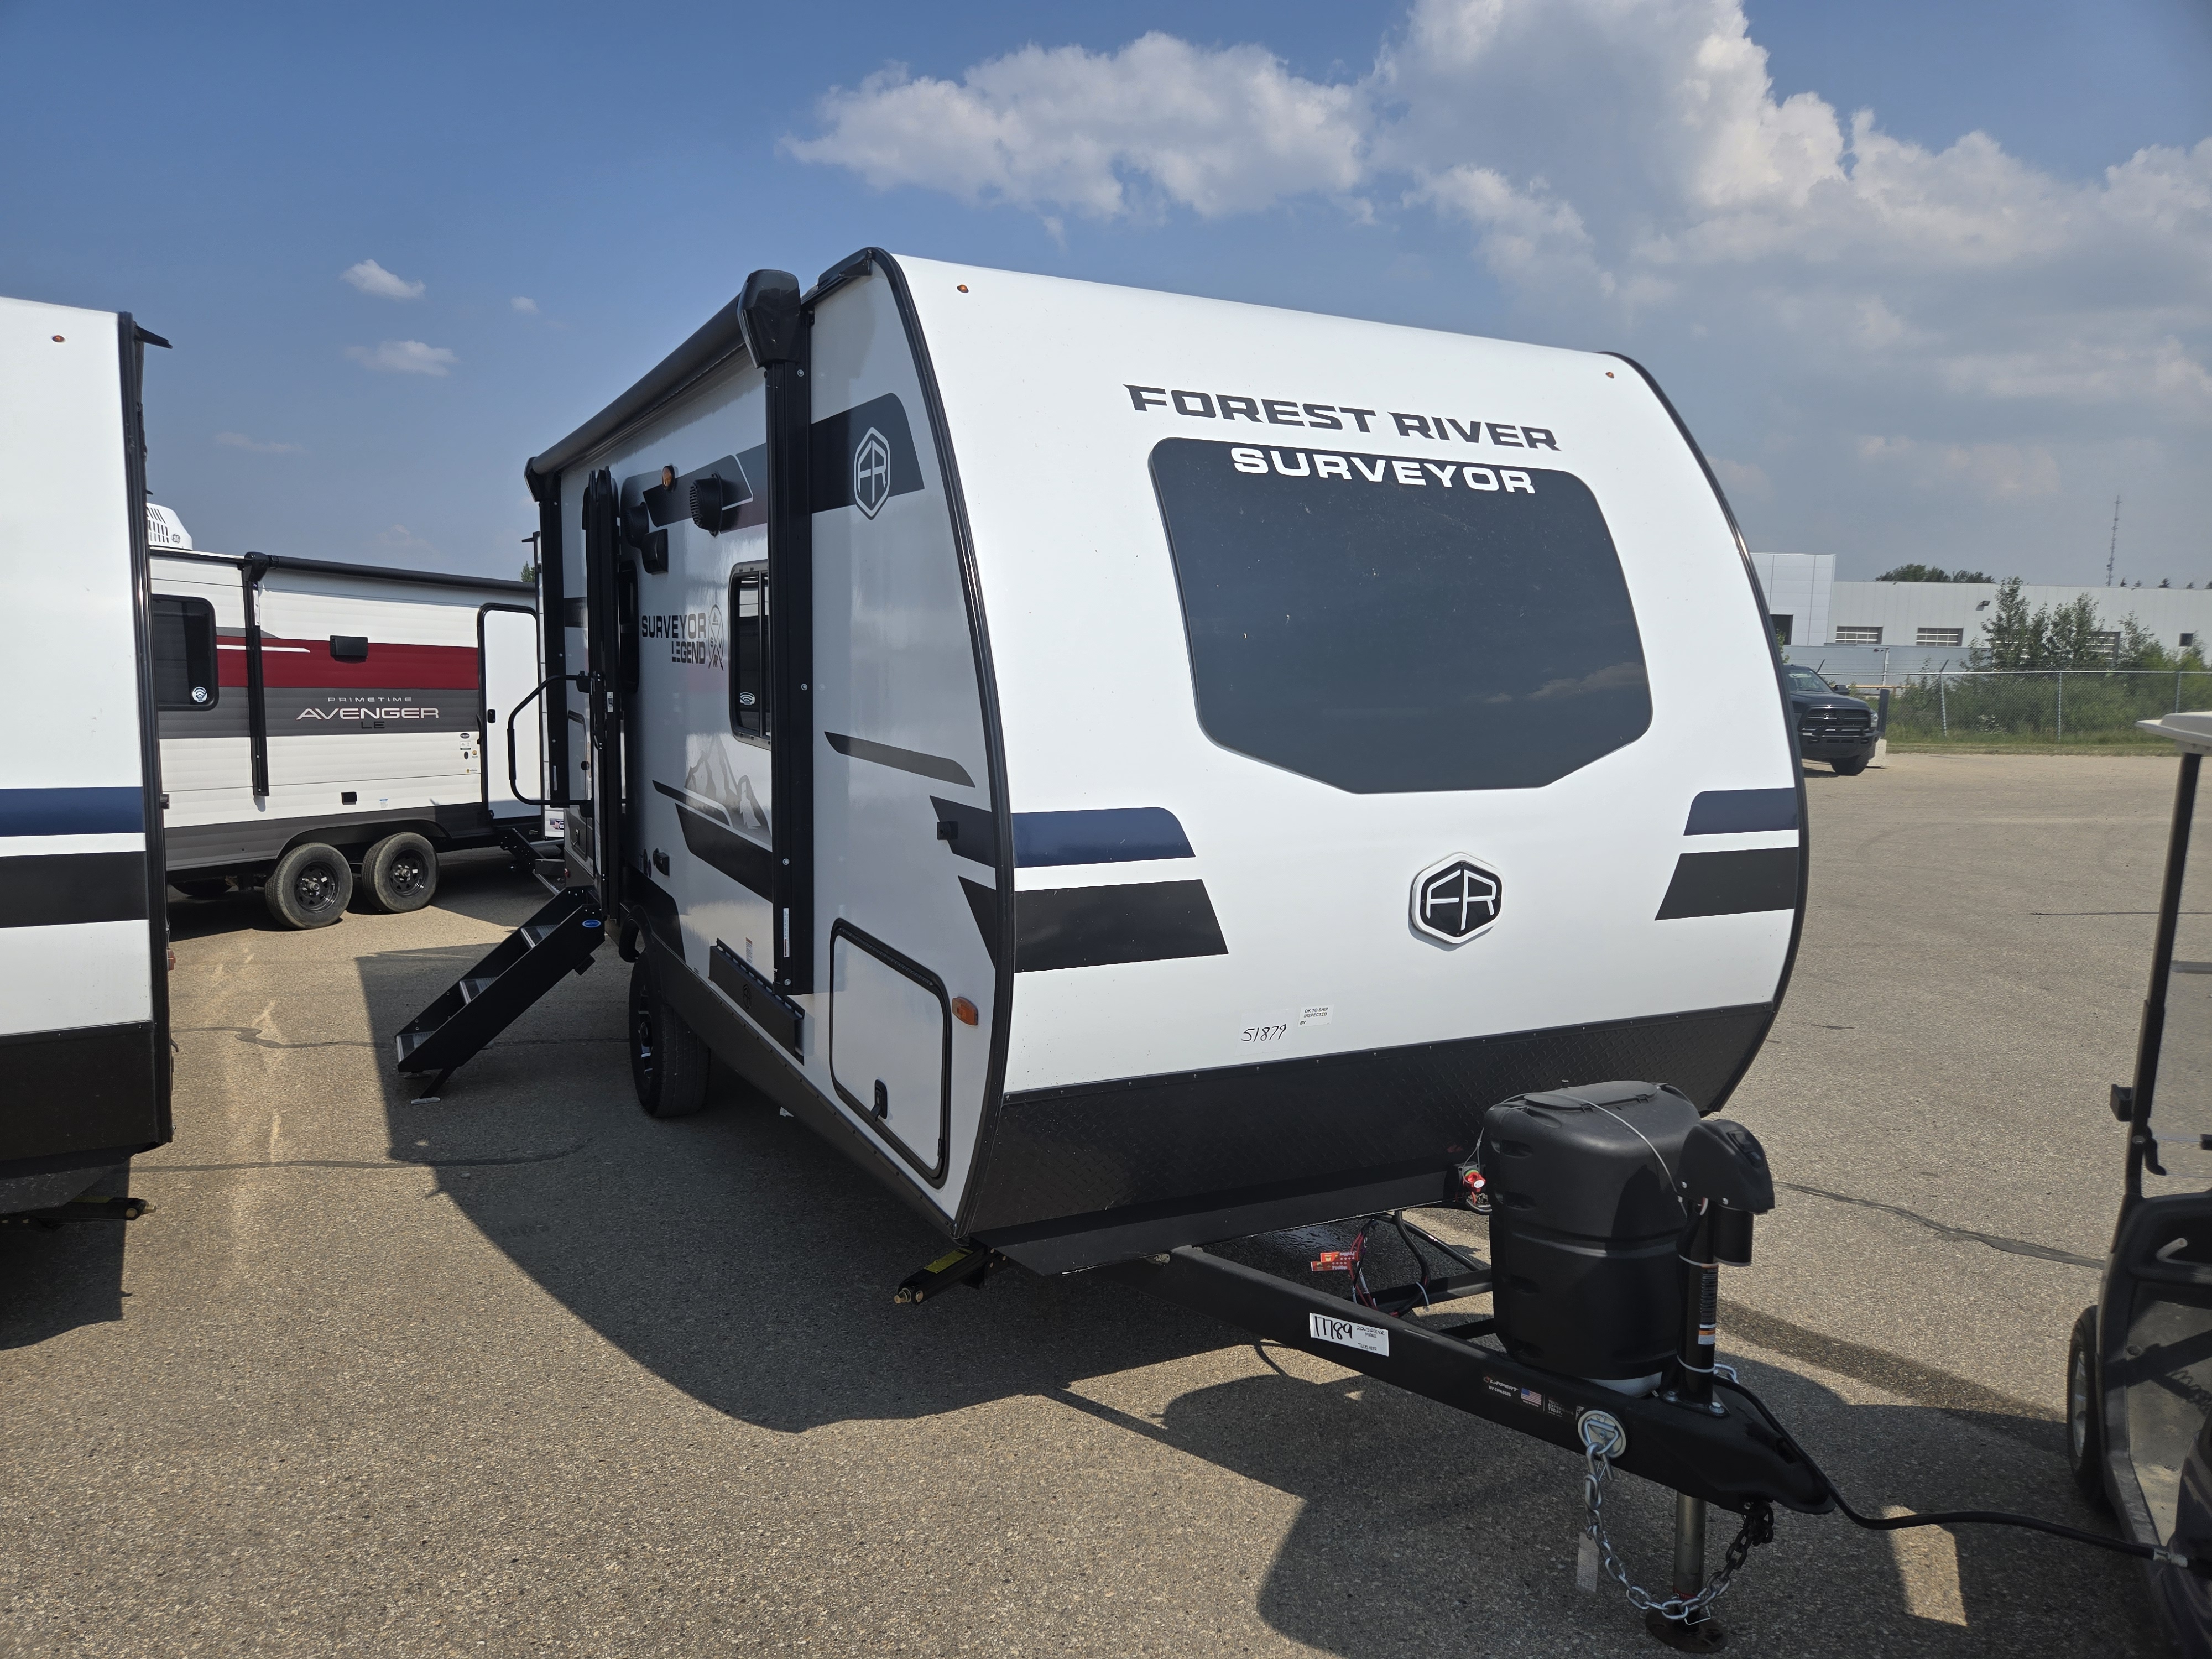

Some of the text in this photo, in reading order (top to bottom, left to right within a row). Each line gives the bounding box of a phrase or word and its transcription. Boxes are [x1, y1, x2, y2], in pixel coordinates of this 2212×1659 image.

[1123, 384, 1562, 451] FOREST RIVER
[1233, 447, 1536, 494] SURVEYOR
[641, 612, 707, 639] SURVEYOR
[671, 641, 706, 664] LEGEND
[296, 707, 439, 720] AVENGER
[1240, 1024, 1287, 1043] 51879
[1314, 1316, 1353, 1340] 17789
[1494, 1387, 1511, 1397] CHASSIS
